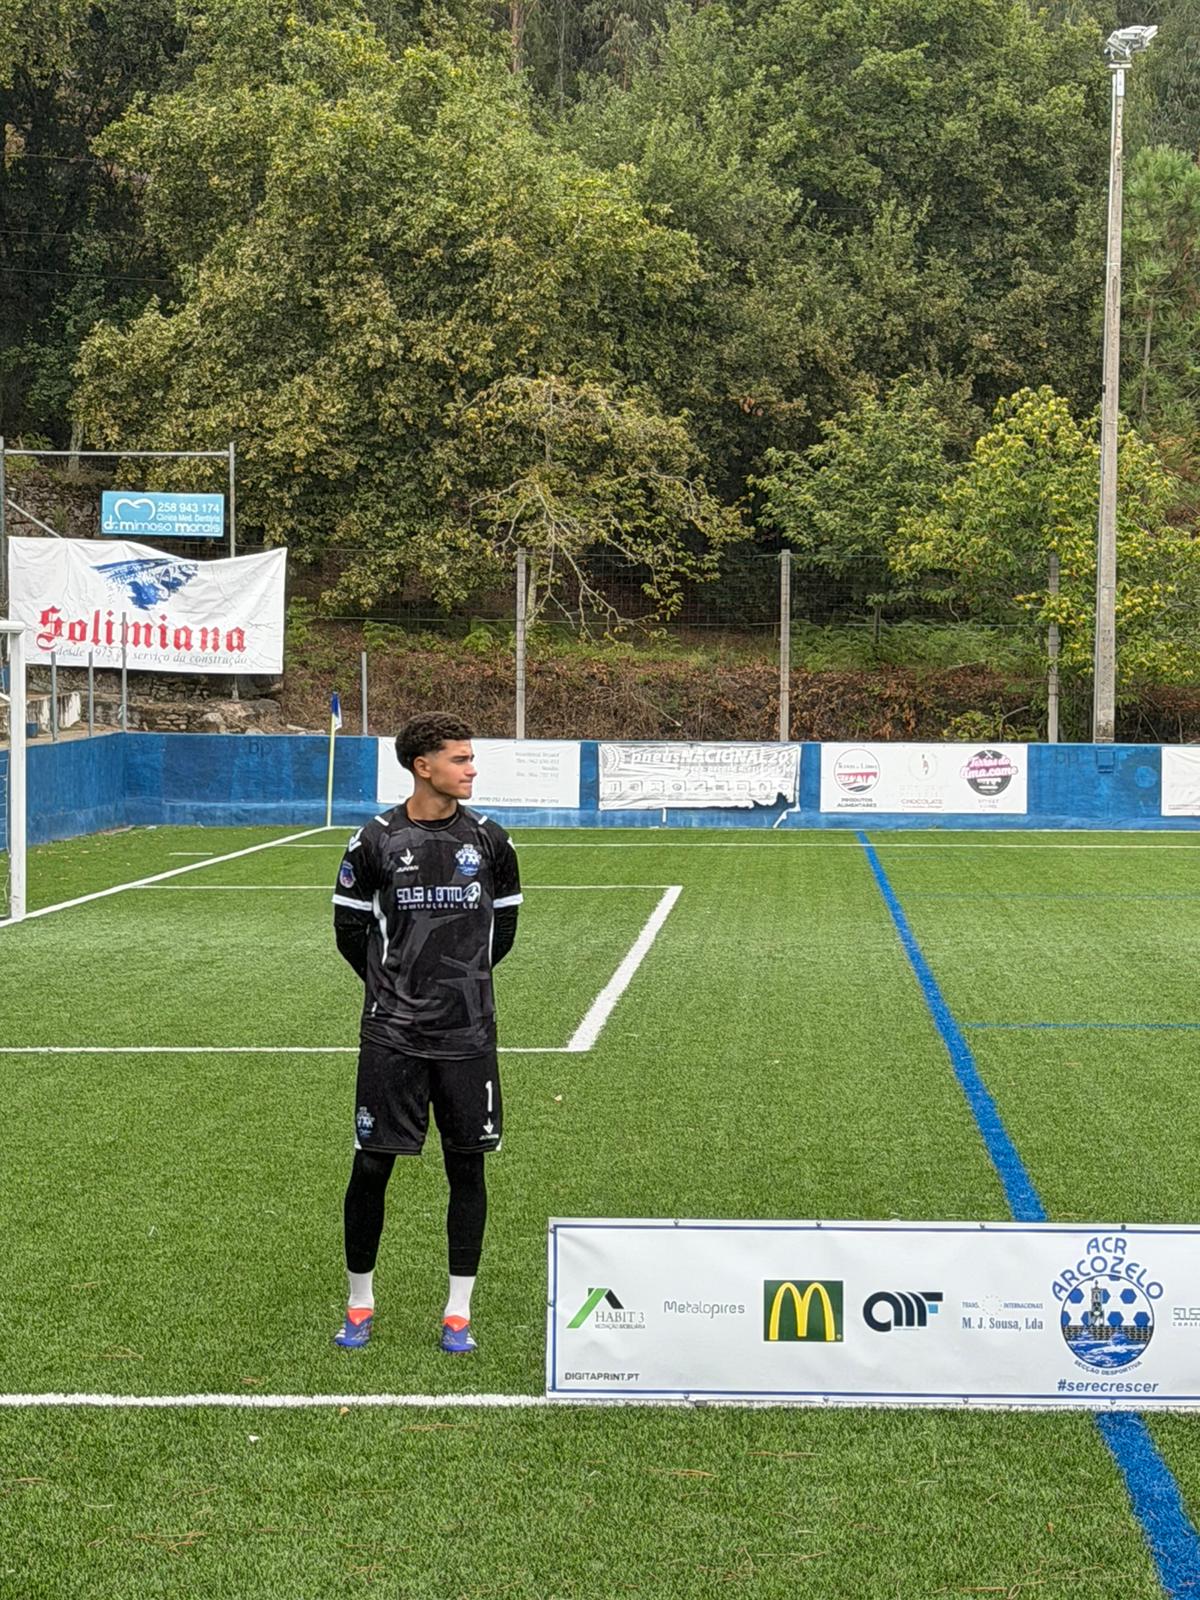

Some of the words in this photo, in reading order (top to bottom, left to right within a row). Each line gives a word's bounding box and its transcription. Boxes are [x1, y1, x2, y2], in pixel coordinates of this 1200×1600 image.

[158, 502, 177, 513] 258
[179, 503, 198, 513] 943
[202, 504, 219, 513] 174
[485, 1080, 493, 1113] 1
[1086, 1236, 1128, 1256] ACR
[1052, 1255, 1164, 1301] ARCOZELO
[664, 1300, 746, 1319] Metalopires
[595, 1311, 635, 1324] HABIT
[638, 1312, 646, 1324] 3
[962, 1317, 975, 1330] M.
[978, 1317, 986, 1330] J.
[989, 1317, 1022, 1332] Sousa,
[1025, 1318, 1044, 1330] Lda
[564, 1371, 640, 1382] DIGITAPRINT.PT
[1057, 1379, 1159, 1393] #serecrescer
